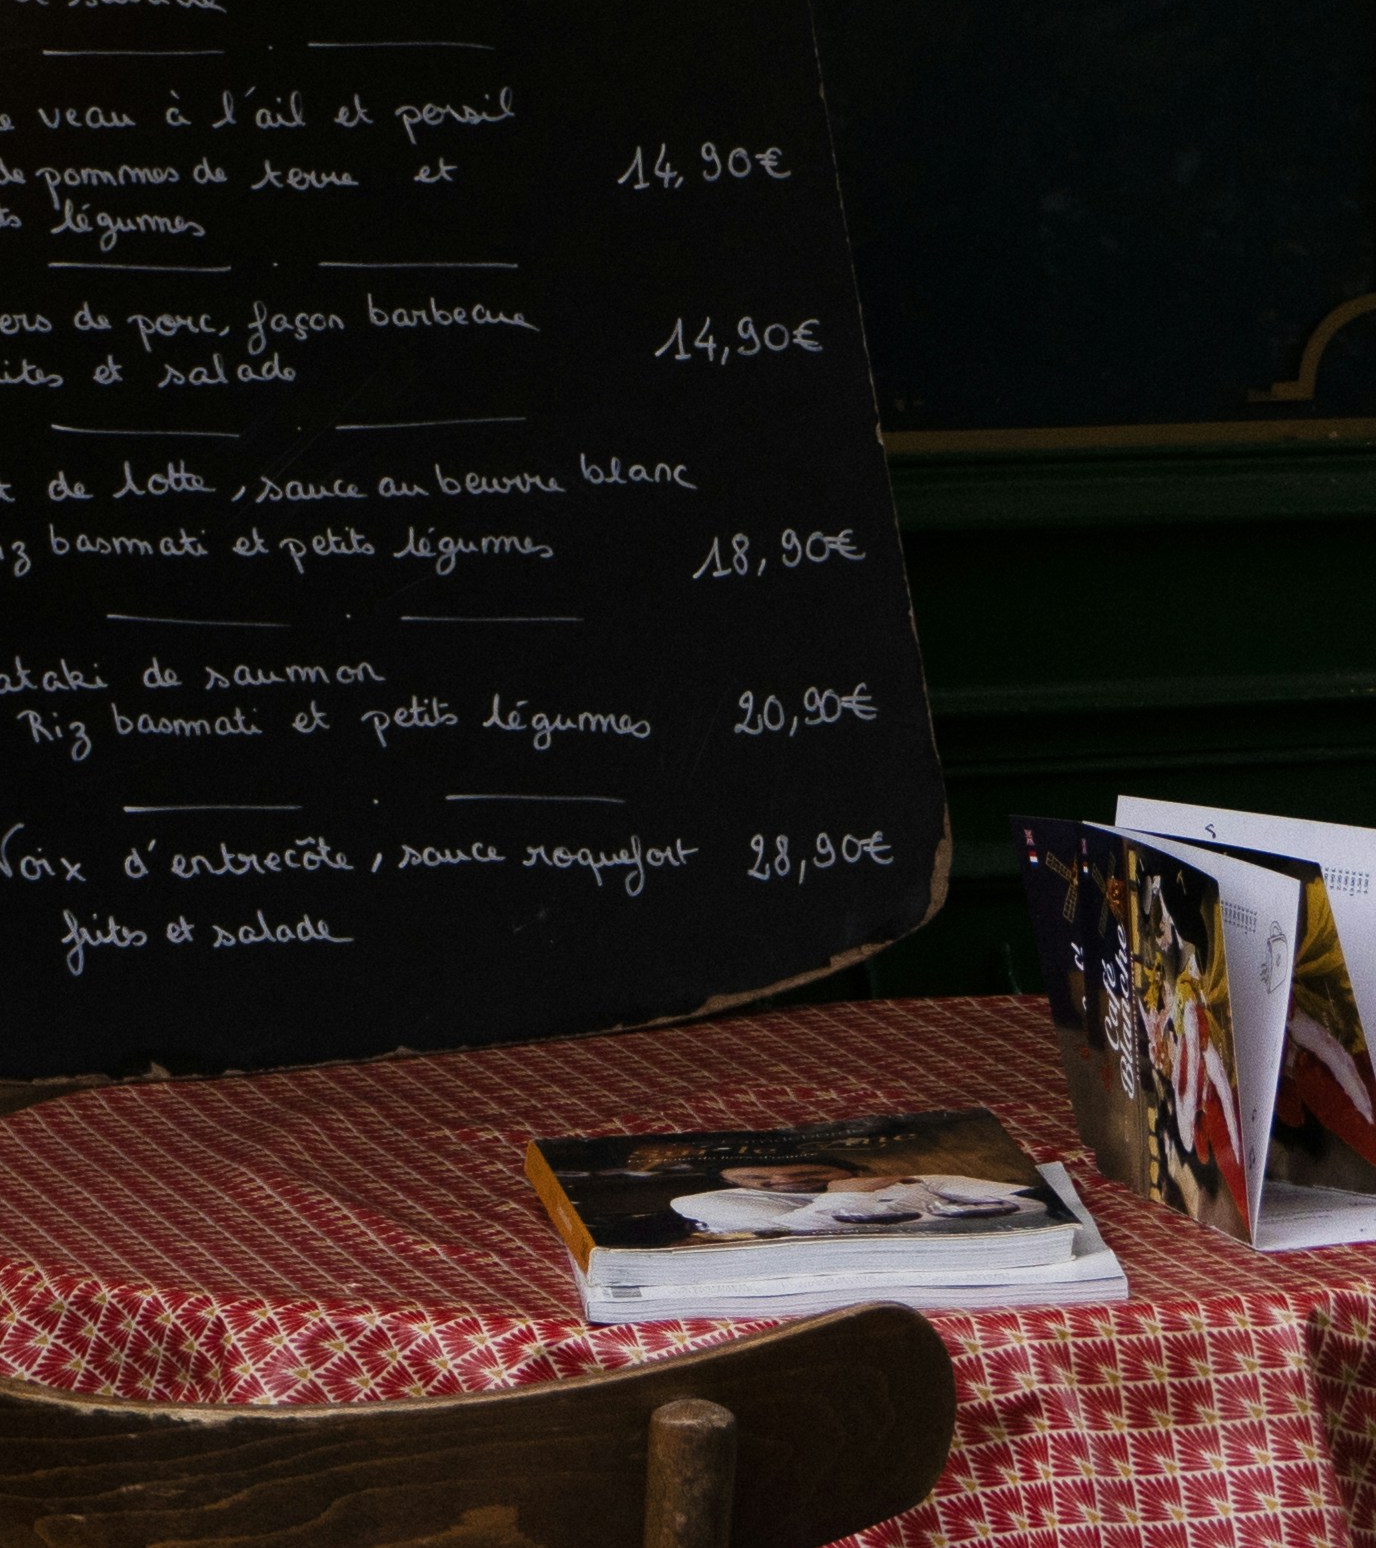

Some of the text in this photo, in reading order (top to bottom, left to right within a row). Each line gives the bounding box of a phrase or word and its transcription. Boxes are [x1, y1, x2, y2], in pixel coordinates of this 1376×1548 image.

[37, 105, 136, 130] veau
[164, 89, 192, 128] à
[333, 93, 374, 129] et
[34, 163, 181, 212] pommes
[191, 156, 228, 185] de
[412, 157, 458, 185] et
[49, 198, 206, 253] légumes
[72, 301, 113, 332] de
[247, 300, 346, 357] façon
[653, 315, 824, 366] 14,90€
[92, 353, 124, 386] et
[157, 351, 297, 389] salade
[46, 469, 94, 503] de
[254, 475, 368, 505] sauce
[377, 475, 430, 499] au
[433, 463, 566, 496] beurre
[579, 452, 698, 490] blanc
[48, 523, 209, 558] basmati
[231, 526, 270, 558] et
[278, 526, 376, 575] petits
[392, 525, 555, 577] légumes
[141, 656, 183, 690] de
[15, 692, 652, 763] Riz basmati et petits légumes
[397, 841, 507, 870] sauce
[521, 834, 700, 898] roquefort
[746, 829, 895, 885] 28,90€
[165, 914, 195, 945] et
[211, 909, 355, 949] salade
[1100, 957, 1120, 1052] Café
[1117, 922, 1136, 1099] Blanche
